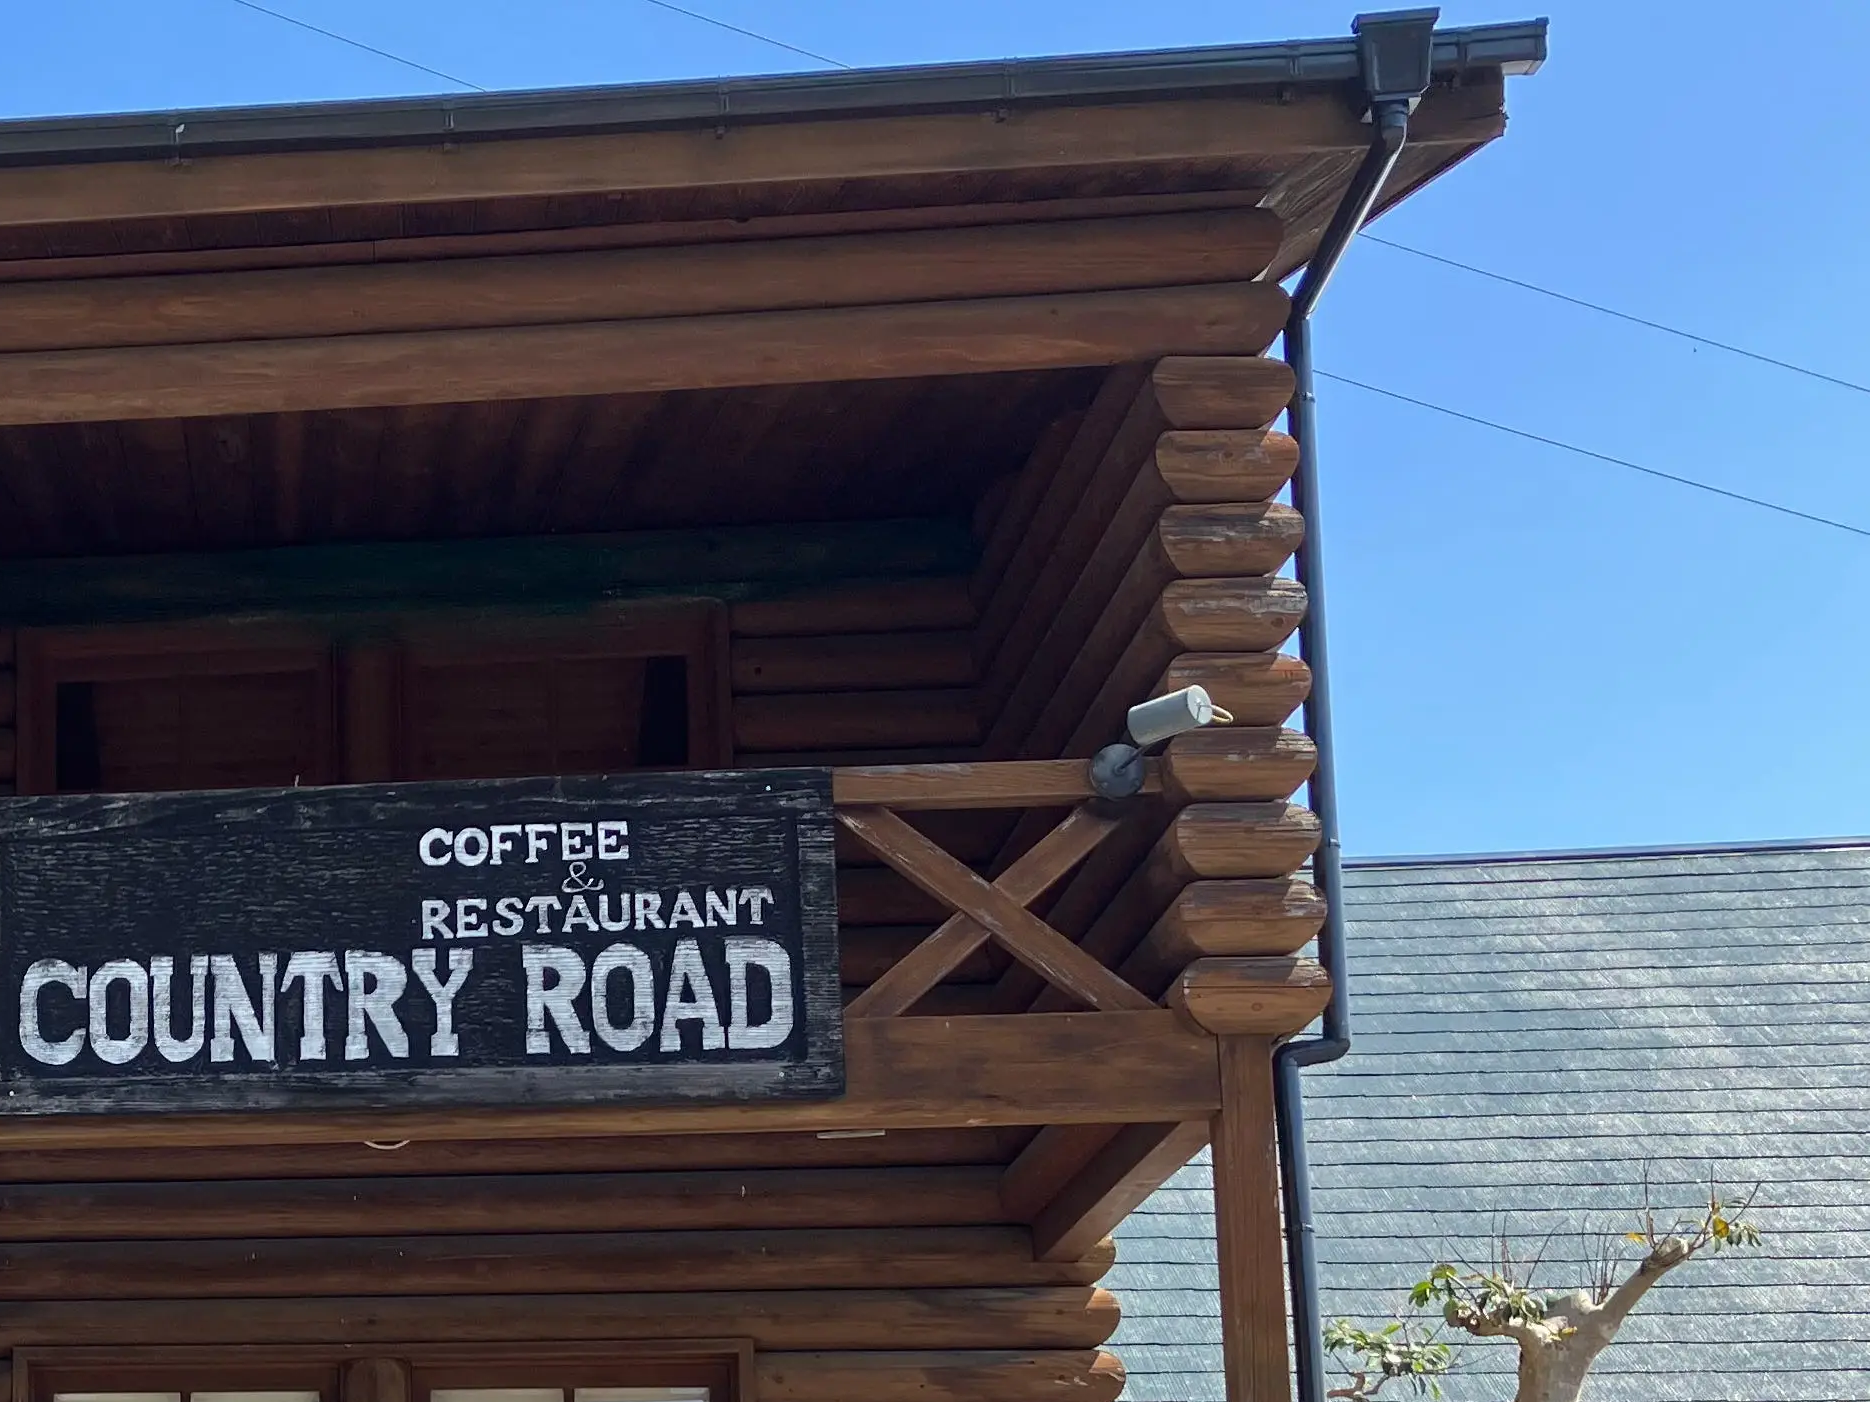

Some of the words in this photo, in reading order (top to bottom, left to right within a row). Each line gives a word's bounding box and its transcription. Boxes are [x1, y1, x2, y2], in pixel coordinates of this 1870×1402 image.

[419, 821, 629, 866] COFFEE
[561, 861, 605, 893] &
[421, 887, 775, 940] RESTAURANT
[19, 946, 473, 1066] COUNTRY
[521, 937, 795, 1055] ROAD
